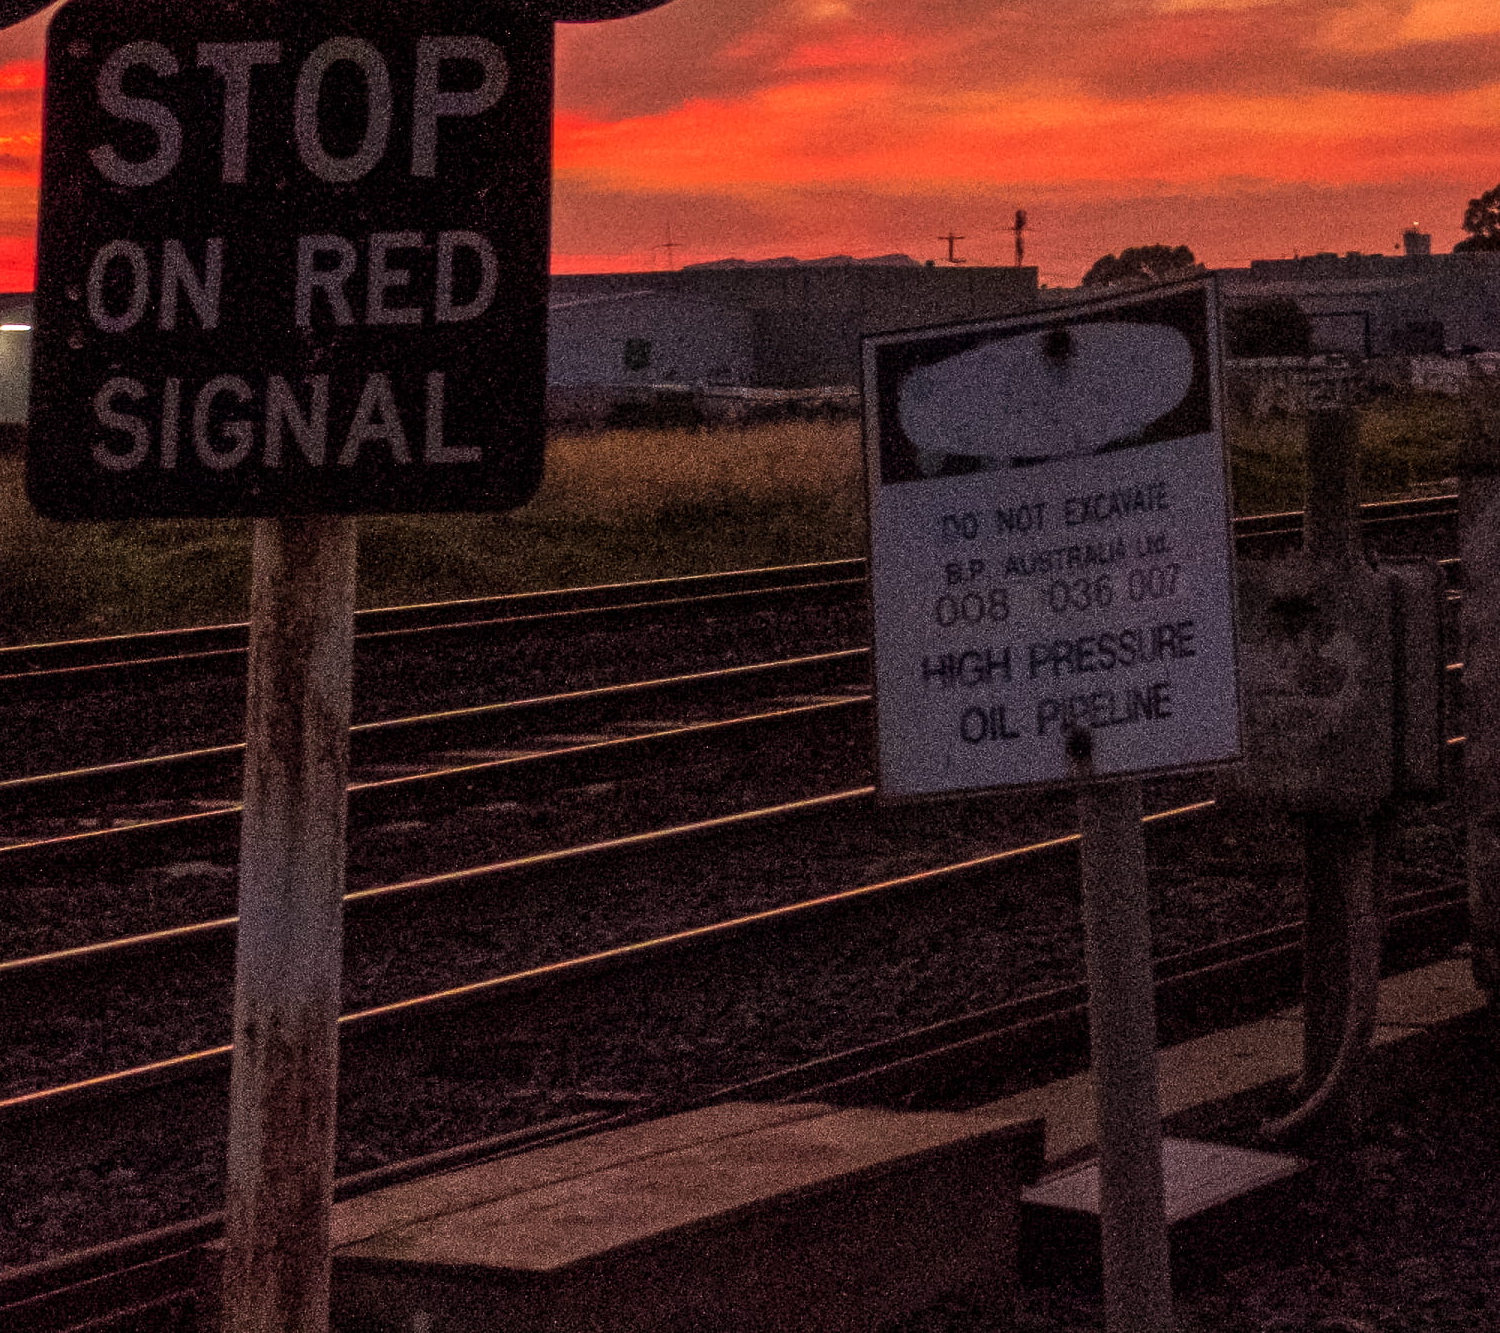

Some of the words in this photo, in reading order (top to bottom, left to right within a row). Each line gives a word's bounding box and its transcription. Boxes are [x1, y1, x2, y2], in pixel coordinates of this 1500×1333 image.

[90, 34, 509, 187] STOP
[86, 236, 228, 332] ON
[295, 229, 500, 328] RED
[93, 371, 484, 471] SIGNAL
[941, 511, 979, 541] DO
[996, 502, 1047, 533] NOT
[1063, 482, 1170, 527] EXCAVATE
[1003, 537, 1127, 576] AUSTRALIA
[935, 588, 1011, 628] 008
[1048, 574, 1114, 614] 036
[1128, 563, 1182, 603] 007
[921, 645, 1012, 687] HIGH
[1029, 619, 1197, 679] PRESSURE
[960, 705, 1020, 744] OIL
[1037, 681, 1173, 736] PIPELINE
